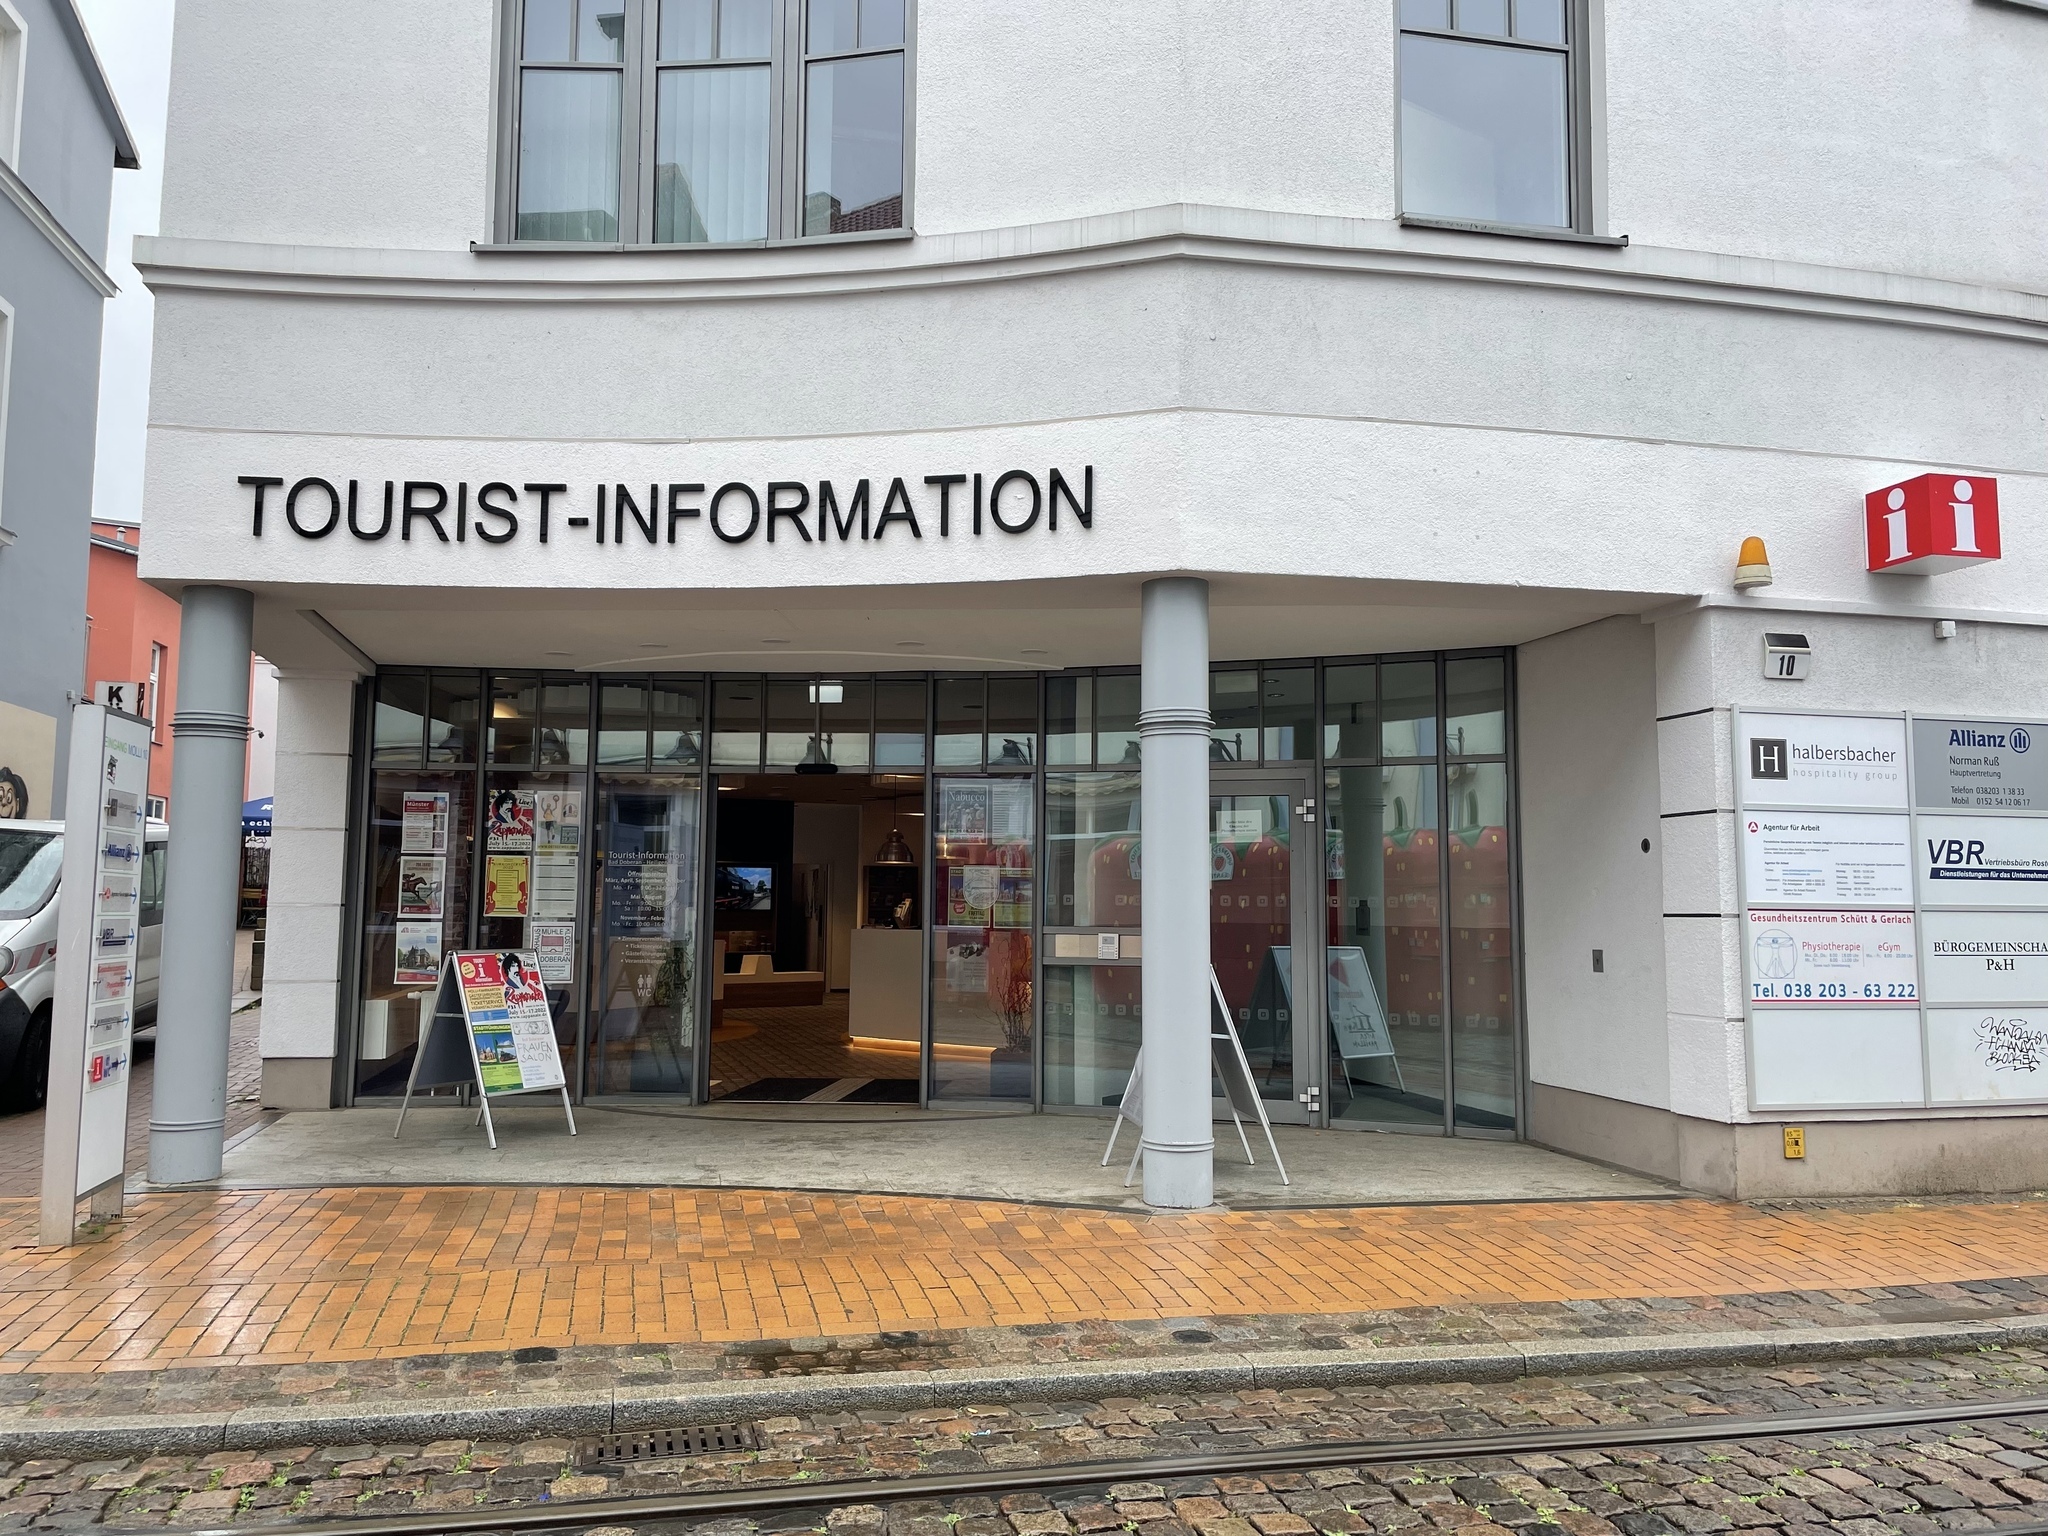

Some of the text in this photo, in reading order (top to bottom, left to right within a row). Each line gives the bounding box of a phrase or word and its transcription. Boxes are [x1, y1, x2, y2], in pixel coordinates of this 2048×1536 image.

[238, 465, 1093, 544] TOURIST-INFORMATION
[1948, 479, 1981, 552] i
[1883, 487, 1912, 562] i
[1779, 655, 1796, 676] 10
[1948, 728, 2006, 749] Allianz
[1759, 743, 1897, 773] H halbersbacher
[1949, 756, 2000, 767] Norman Ruß
[1793, 767, 1898, 782] hospitality group
[1949, 768, 2001, 780] Hauptvertretung
[949, 791, 985, 801] Nabucco
[1951, 785, 1974, 795] Telefon
[1976, 786, 2000, 796] 038203
[1951, 796, 1970, 806] Mobil
[1976, 797, 1993, 806] 0152
[1763, 823, 1820, 833] Agentur für Arbeit
[608, 850, 685, 860] Tourist-Information
[1927, 839, 1985, 865] VBR
[1985, 857, 2030, 867] Vertriebsbüro
[1940, 869, 1989, 879] Dienstleistungen
[1990, 870, 1999, 878] für
[2000, 871, 2010, 879] das
[1750, 913, 1912, 924] Gesundheitszentrum Schütt & Gerlach
[1802, 941, 1901, 953] Physiotherapie eGym
[1933, 939, 2048, 953] BÜROGEMEINSCHA
[1986, 958, 2015, 971] P&H
[637, 988, 652, 997] WC
[1753, 983, 1779, 998] Tel.
[1783, 983, 1812, 998] 038
[1819, 983, 1846, 998] 203
[1863, 983, 1881, 998] 63
[1888, 983, 1916, 998] 222
[520, 1052, 552, 1063] SALON
